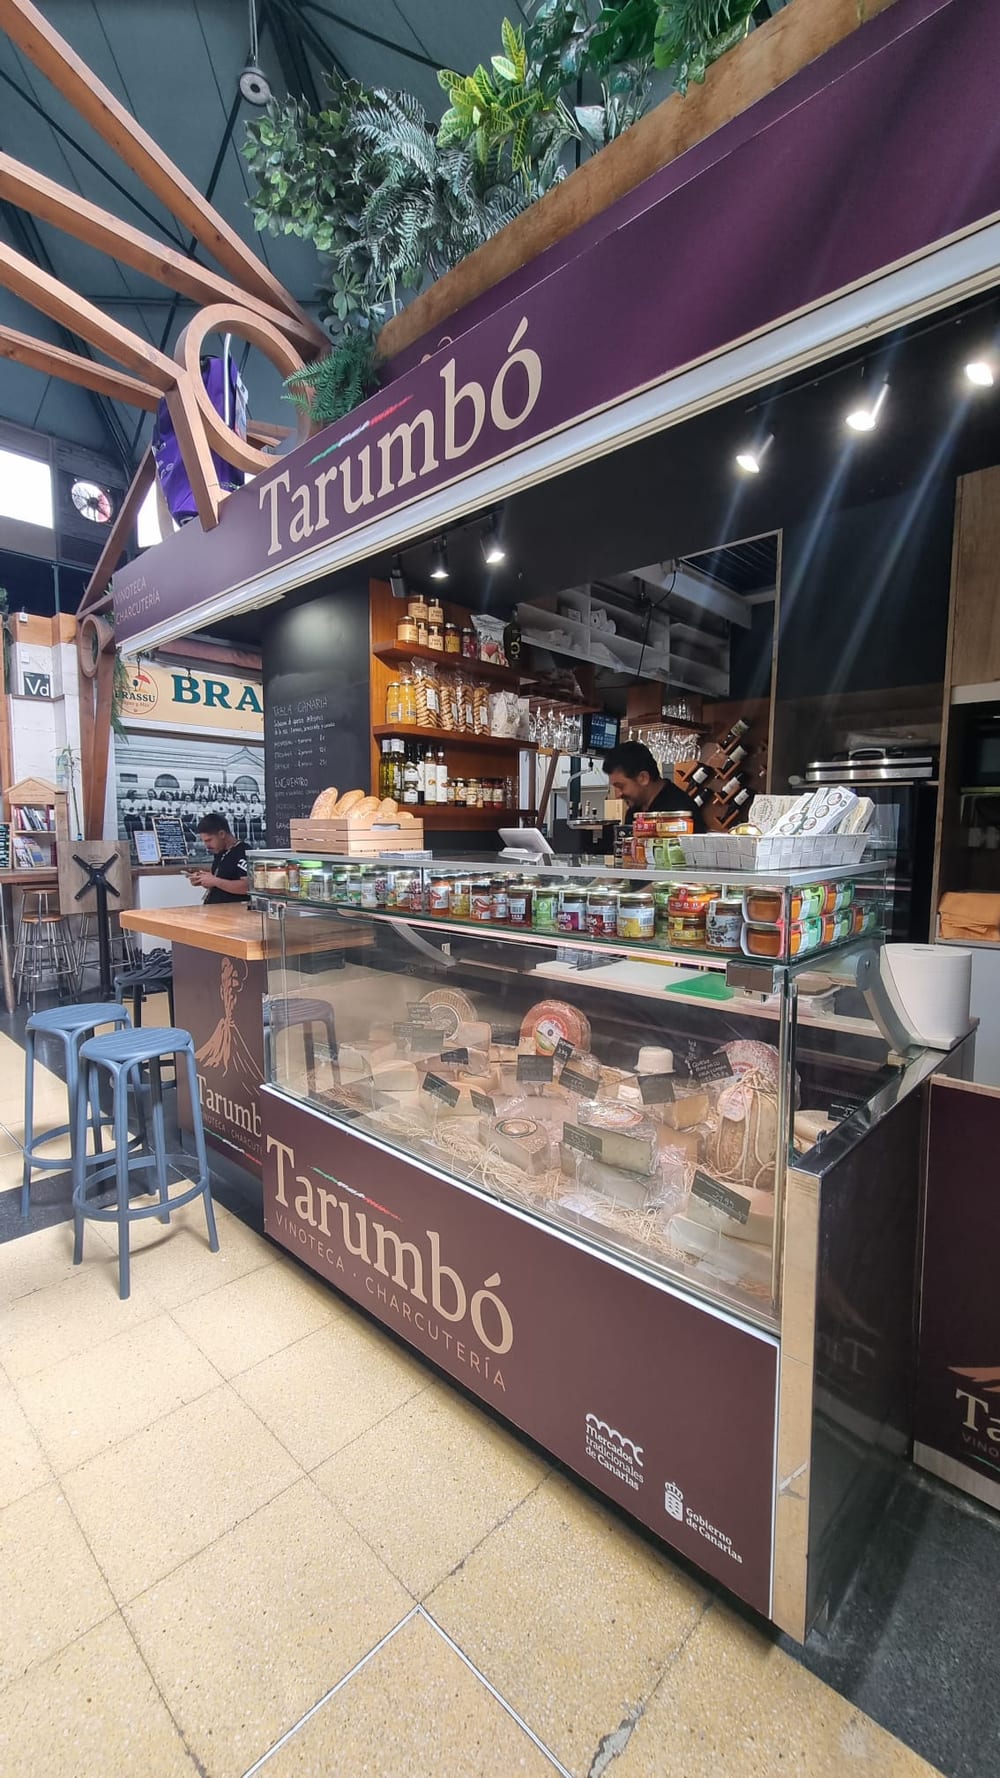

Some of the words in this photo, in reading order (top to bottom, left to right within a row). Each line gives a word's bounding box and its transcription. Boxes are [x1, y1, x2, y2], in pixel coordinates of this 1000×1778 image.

[259, 316, 543, 556] Tarumbó
[114, 576, 147, 605] VINOTECA
[115, 587, 161, 625] CHARCUTERÍA
[25, 677, 50, 697] Vd
[171, 674, 264, 713] BRA
[266, 1134, 514, 1355] Tarumbó
[275, 1211, 345, 1273] VINOTECA
[365, 1276, 506, 1392] CHARCUTERÍA
[585, 1435, 644, 1484] tradicionales
[586, 1423, 633, 1465] mercados
[585, 1446, 597, 1460] de
[597, 1454, 639, 1491] Canarias
[685, 1507, 732, 1546] Gobierno
[685, 1517, 698, 1531] de
[698, 1526, 743, 1564] Canarias
